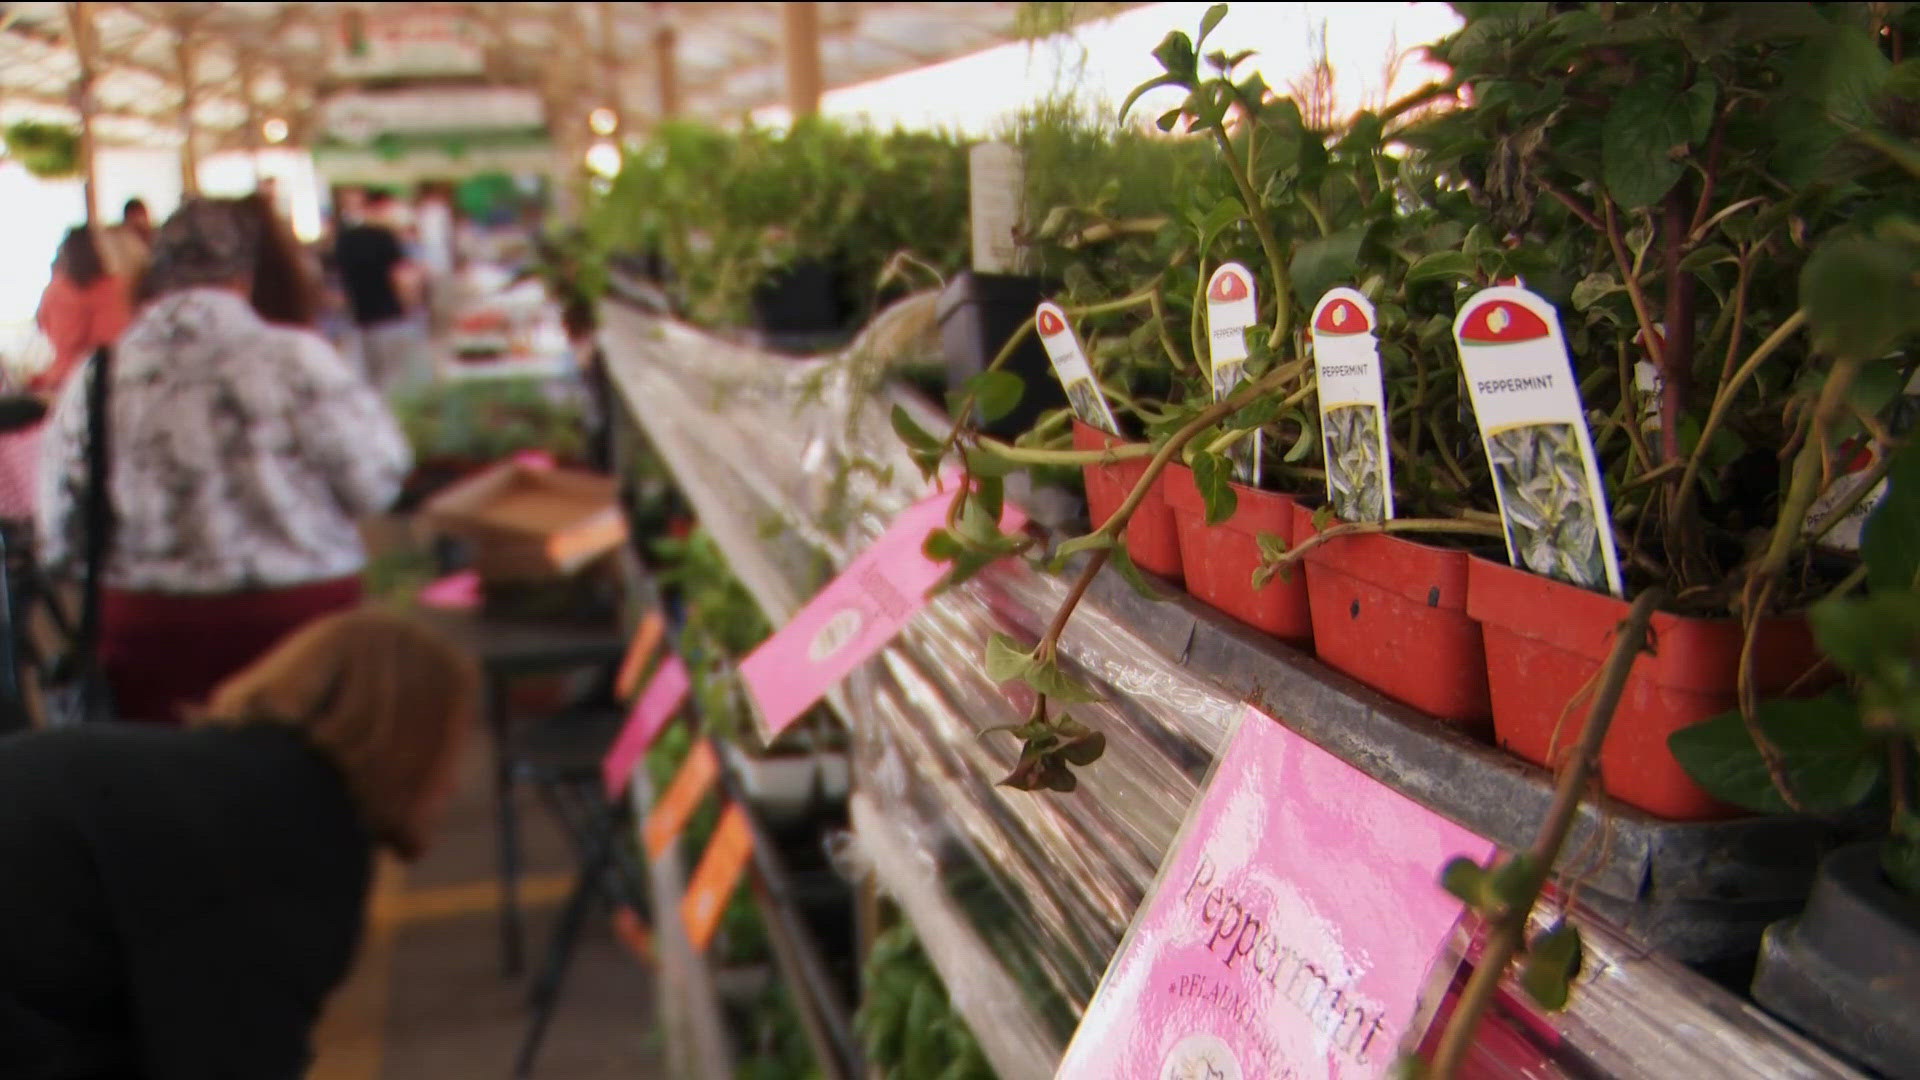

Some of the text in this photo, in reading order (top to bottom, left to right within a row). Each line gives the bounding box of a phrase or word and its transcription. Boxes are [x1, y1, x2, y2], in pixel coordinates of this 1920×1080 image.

[1321, 363, 1368, 377] PEPPERMINT
[1477, 375, 1553, 394] PEPPERMINT
[1184, 853, 1385, 1066] Peppermint
